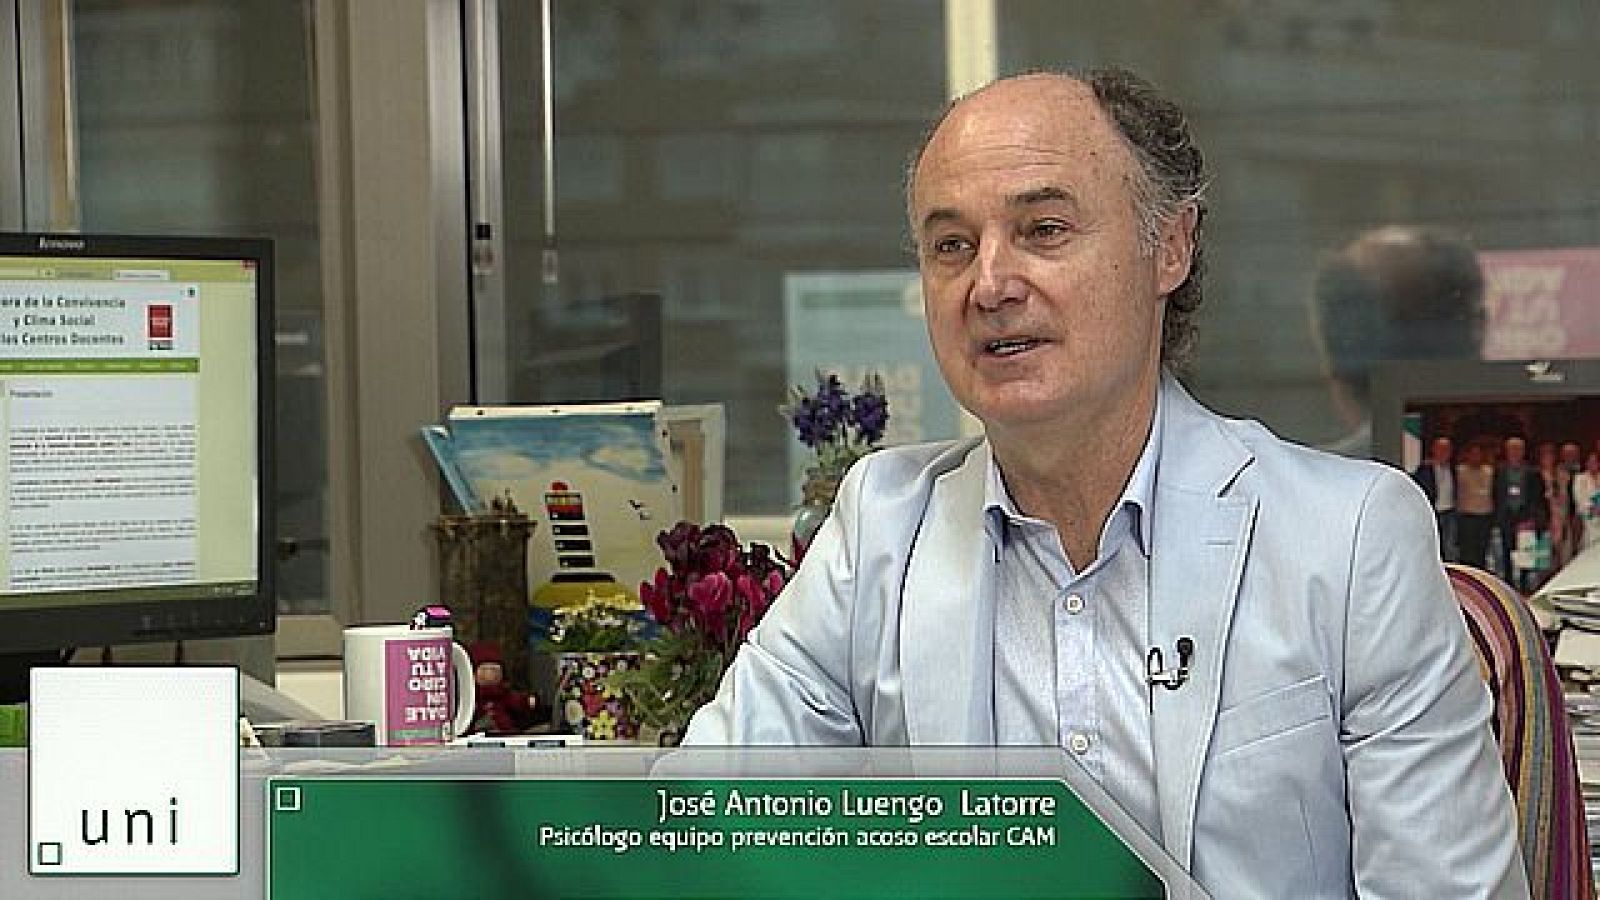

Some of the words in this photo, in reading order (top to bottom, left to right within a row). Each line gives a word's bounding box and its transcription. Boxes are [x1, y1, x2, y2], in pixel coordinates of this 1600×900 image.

[56, 295, 126, 309] Convivencia
[24, 315, 56, 326] Clima
[59, 314, 96, 326] Social
[22, 332, 68, 346] Centros
